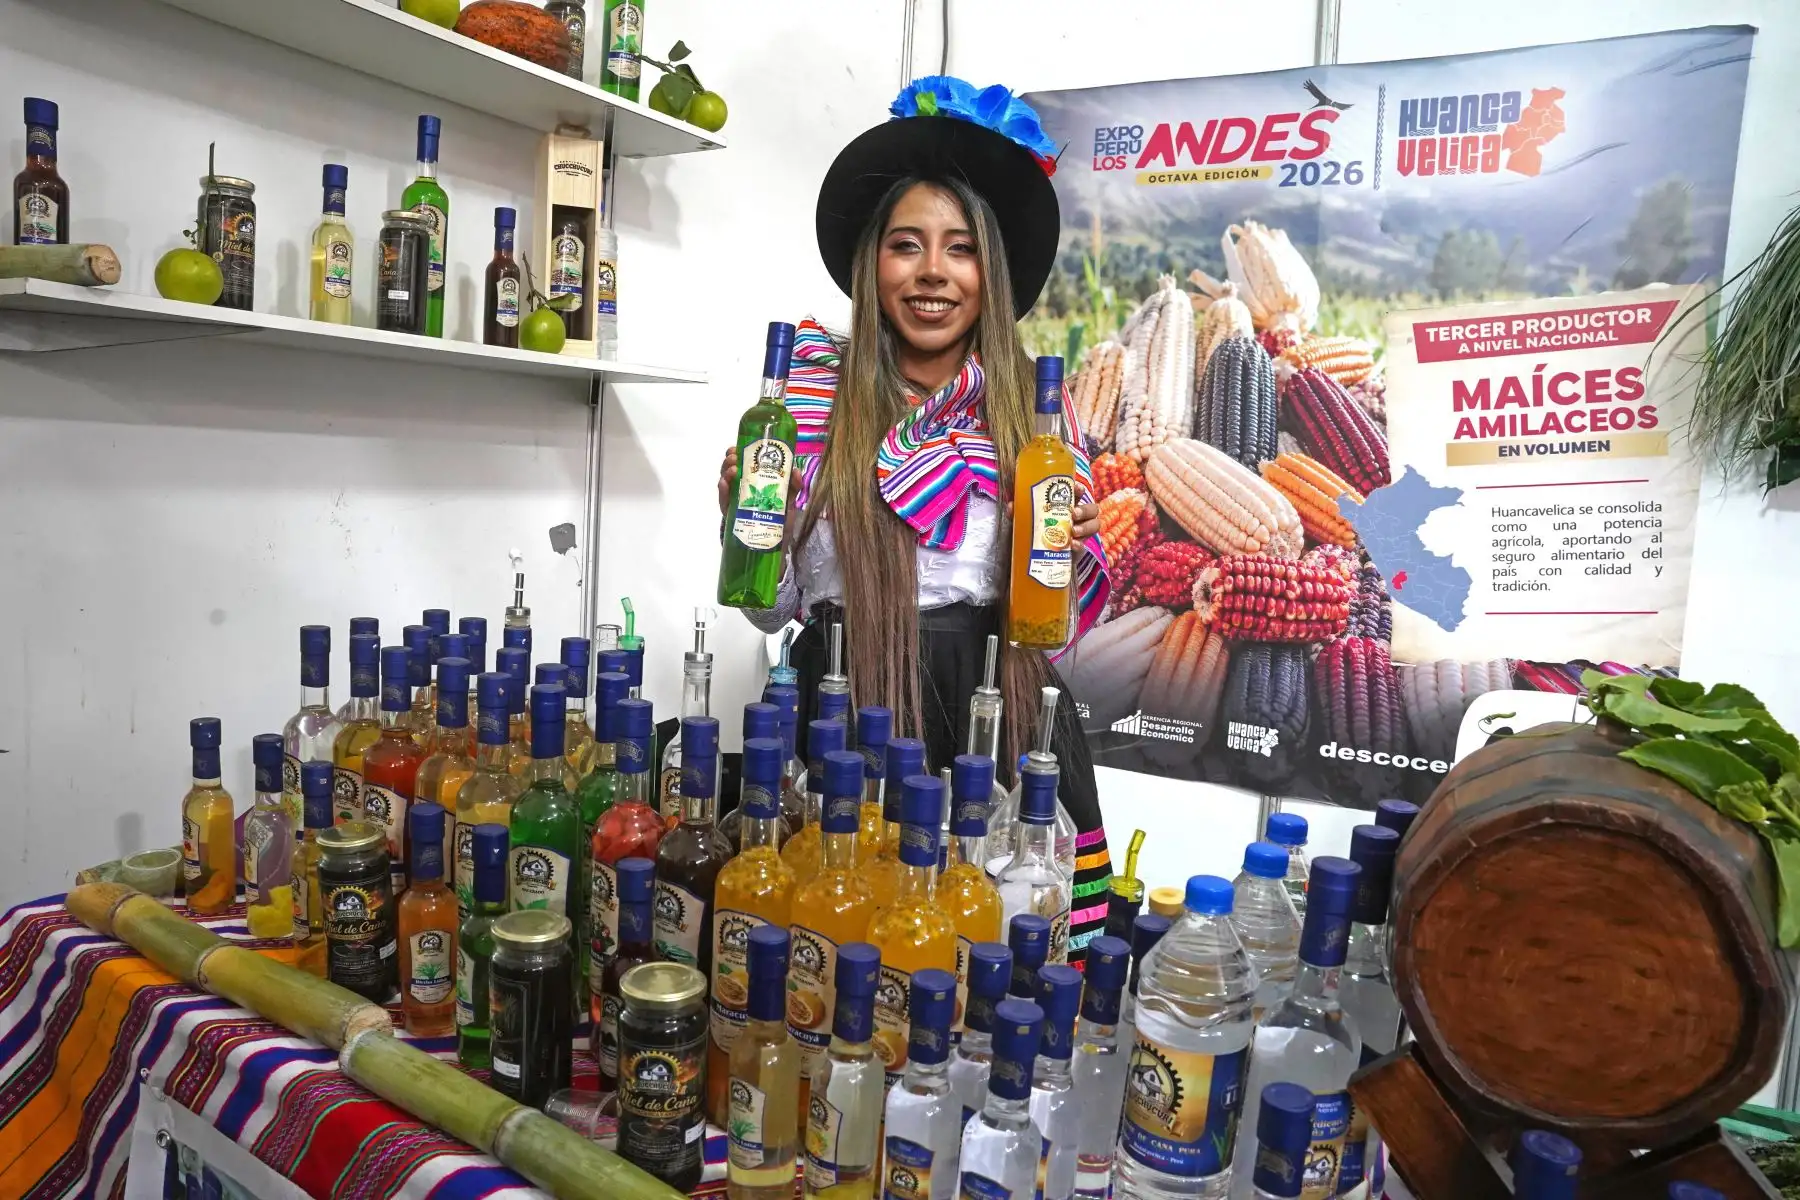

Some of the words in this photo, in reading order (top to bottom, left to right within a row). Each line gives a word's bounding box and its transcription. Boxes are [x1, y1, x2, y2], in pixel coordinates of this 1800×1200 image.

[1095, 124, 1144, 142] EXPO
[1135, 108, 1340, 169] ANDES
[1093, 138, 1142, 156] PERÚ
[1093, 155, 1127, 171] LOS
[1148, 173, 1198, 183] OCTAVA
[1204, 168, 1259, 181] EDICIÓN
[1278, 160, 1364, 188] 2026
[1425, 320, 1505, 342] TERCER
[1511, 307, 1652, 336] PRODUCTOR
[1458, 343, 1470, 354] A
[1473, 338, 1522, 353] NIVEL
[1525, 329, 1618, 350] NACIONAL
[1452, 363, 1645, 412] MAÍCES
[1453, 404, 1659, 440] AMILACEOS
[1498, 444, 1520, 457] EN
[1524, 440, 1611, 455] VOLUMEN
[752, 512, 773, 521] Menta
[1491, 504, 1575, 517] Huancavelica
[1579, 506, 1593, 515] se
[1597, 501, 1662, 515] consolida
[1491, 522, 1527, 532] como
[1553, 522, 1577, 531] una
[1604, 517, 1662, 532] potencia
[1491, 535, 1544, 550] agrícola,
[1562, 533, 1632, 548] aportando
[1651, 532, 1662, 543] al
[1492, 552, 1535, 565] seguro
[1550, 550, 1625, 561] alimentario
[1641, 547, 1662, 559] del
[1492, 566, 1517, 580] país
[1538, 566, 1562, 576] con
[1584, 563, 1632, 576] calidad
[1654, 565, 1663, 577] y
[1492, 580, 1551, 592] tradición.
[1141, 720, 1195, 735] Desarrollo
[1142, 715, 1171, 723] GERENCIA
[1172, 719, 1203, 728] REGIONAL
[1140, 728, 1194, 743] Económico
[344, 925, 358, 934] de
[787, 1026, 820, 1042] aracuyá
[644, 1099, 662, 1110] de
